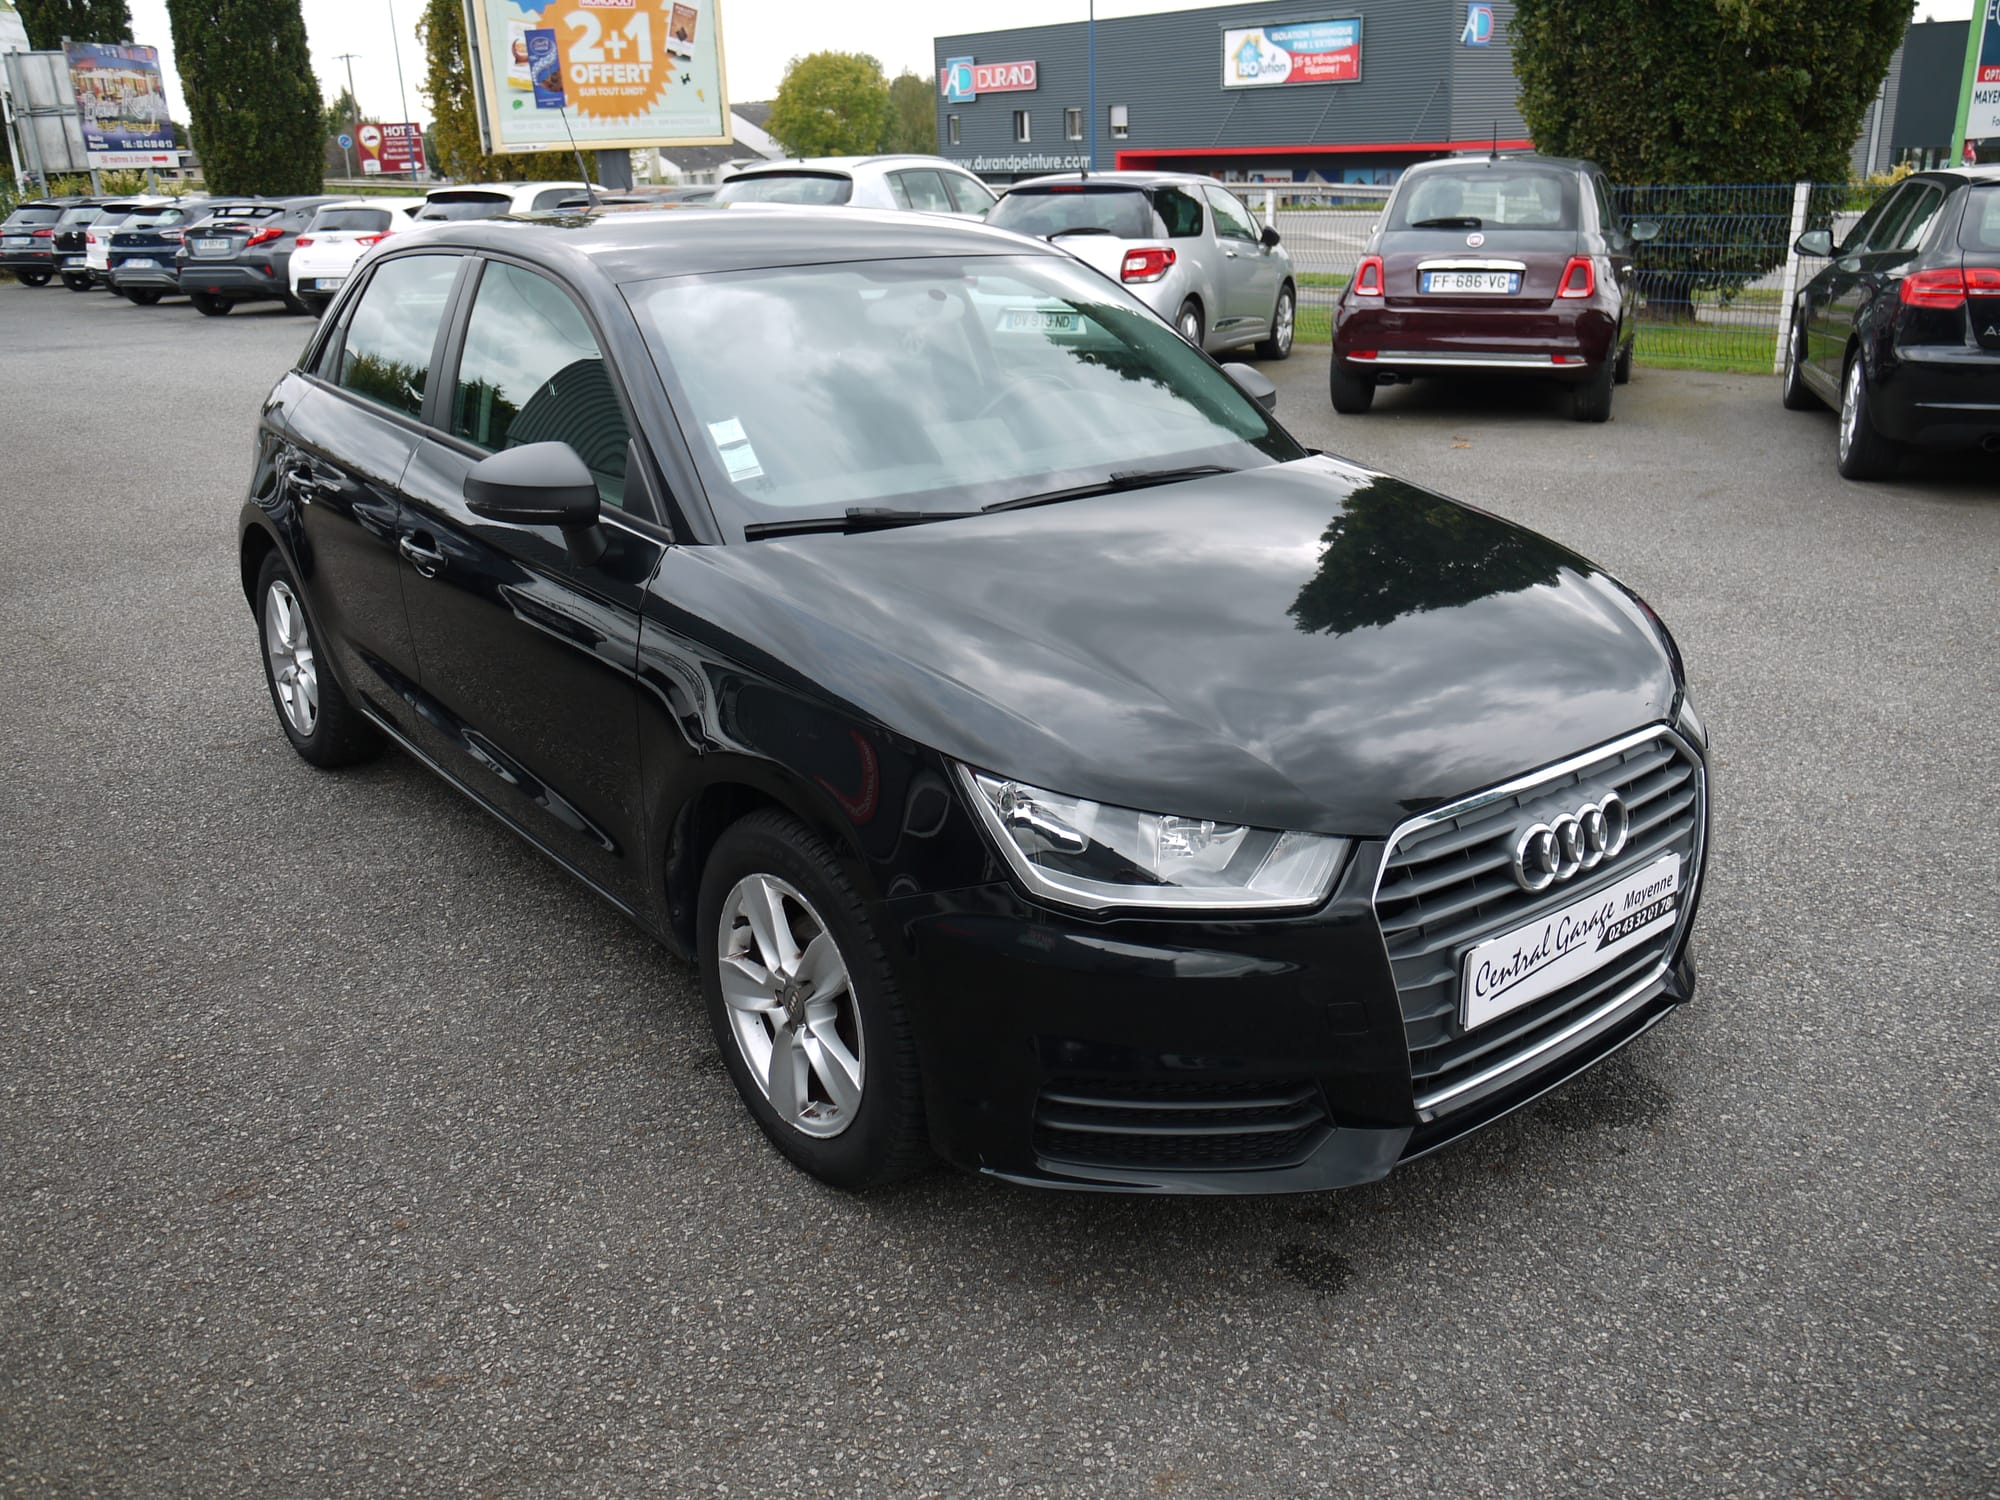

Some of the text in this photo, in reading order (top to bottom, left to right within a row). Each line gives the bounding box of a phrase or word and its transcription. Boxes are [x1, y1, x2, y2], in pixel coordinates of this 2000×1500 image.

[563, 10, 653, 62] 2+1
[1460, 7, 1494, 42] AD
[570, 63, 652, 84] OFFERT
[942, 63, 1035, 96] AD DURAND
[579, 87, 596, 97] SUR
[598, 87, 620, 97] TOUT
[951, 153, 1092, 172] ww.durandpeinture.com
[1475, 874, 1674, 997] Central Garage Mayenne
[1608, 924, 1621, 942] 02
[1621, 916, 1634, 934] 43
[1634, 910, 1647, 928] 32
[1647, 902, 1659, 921] 01
